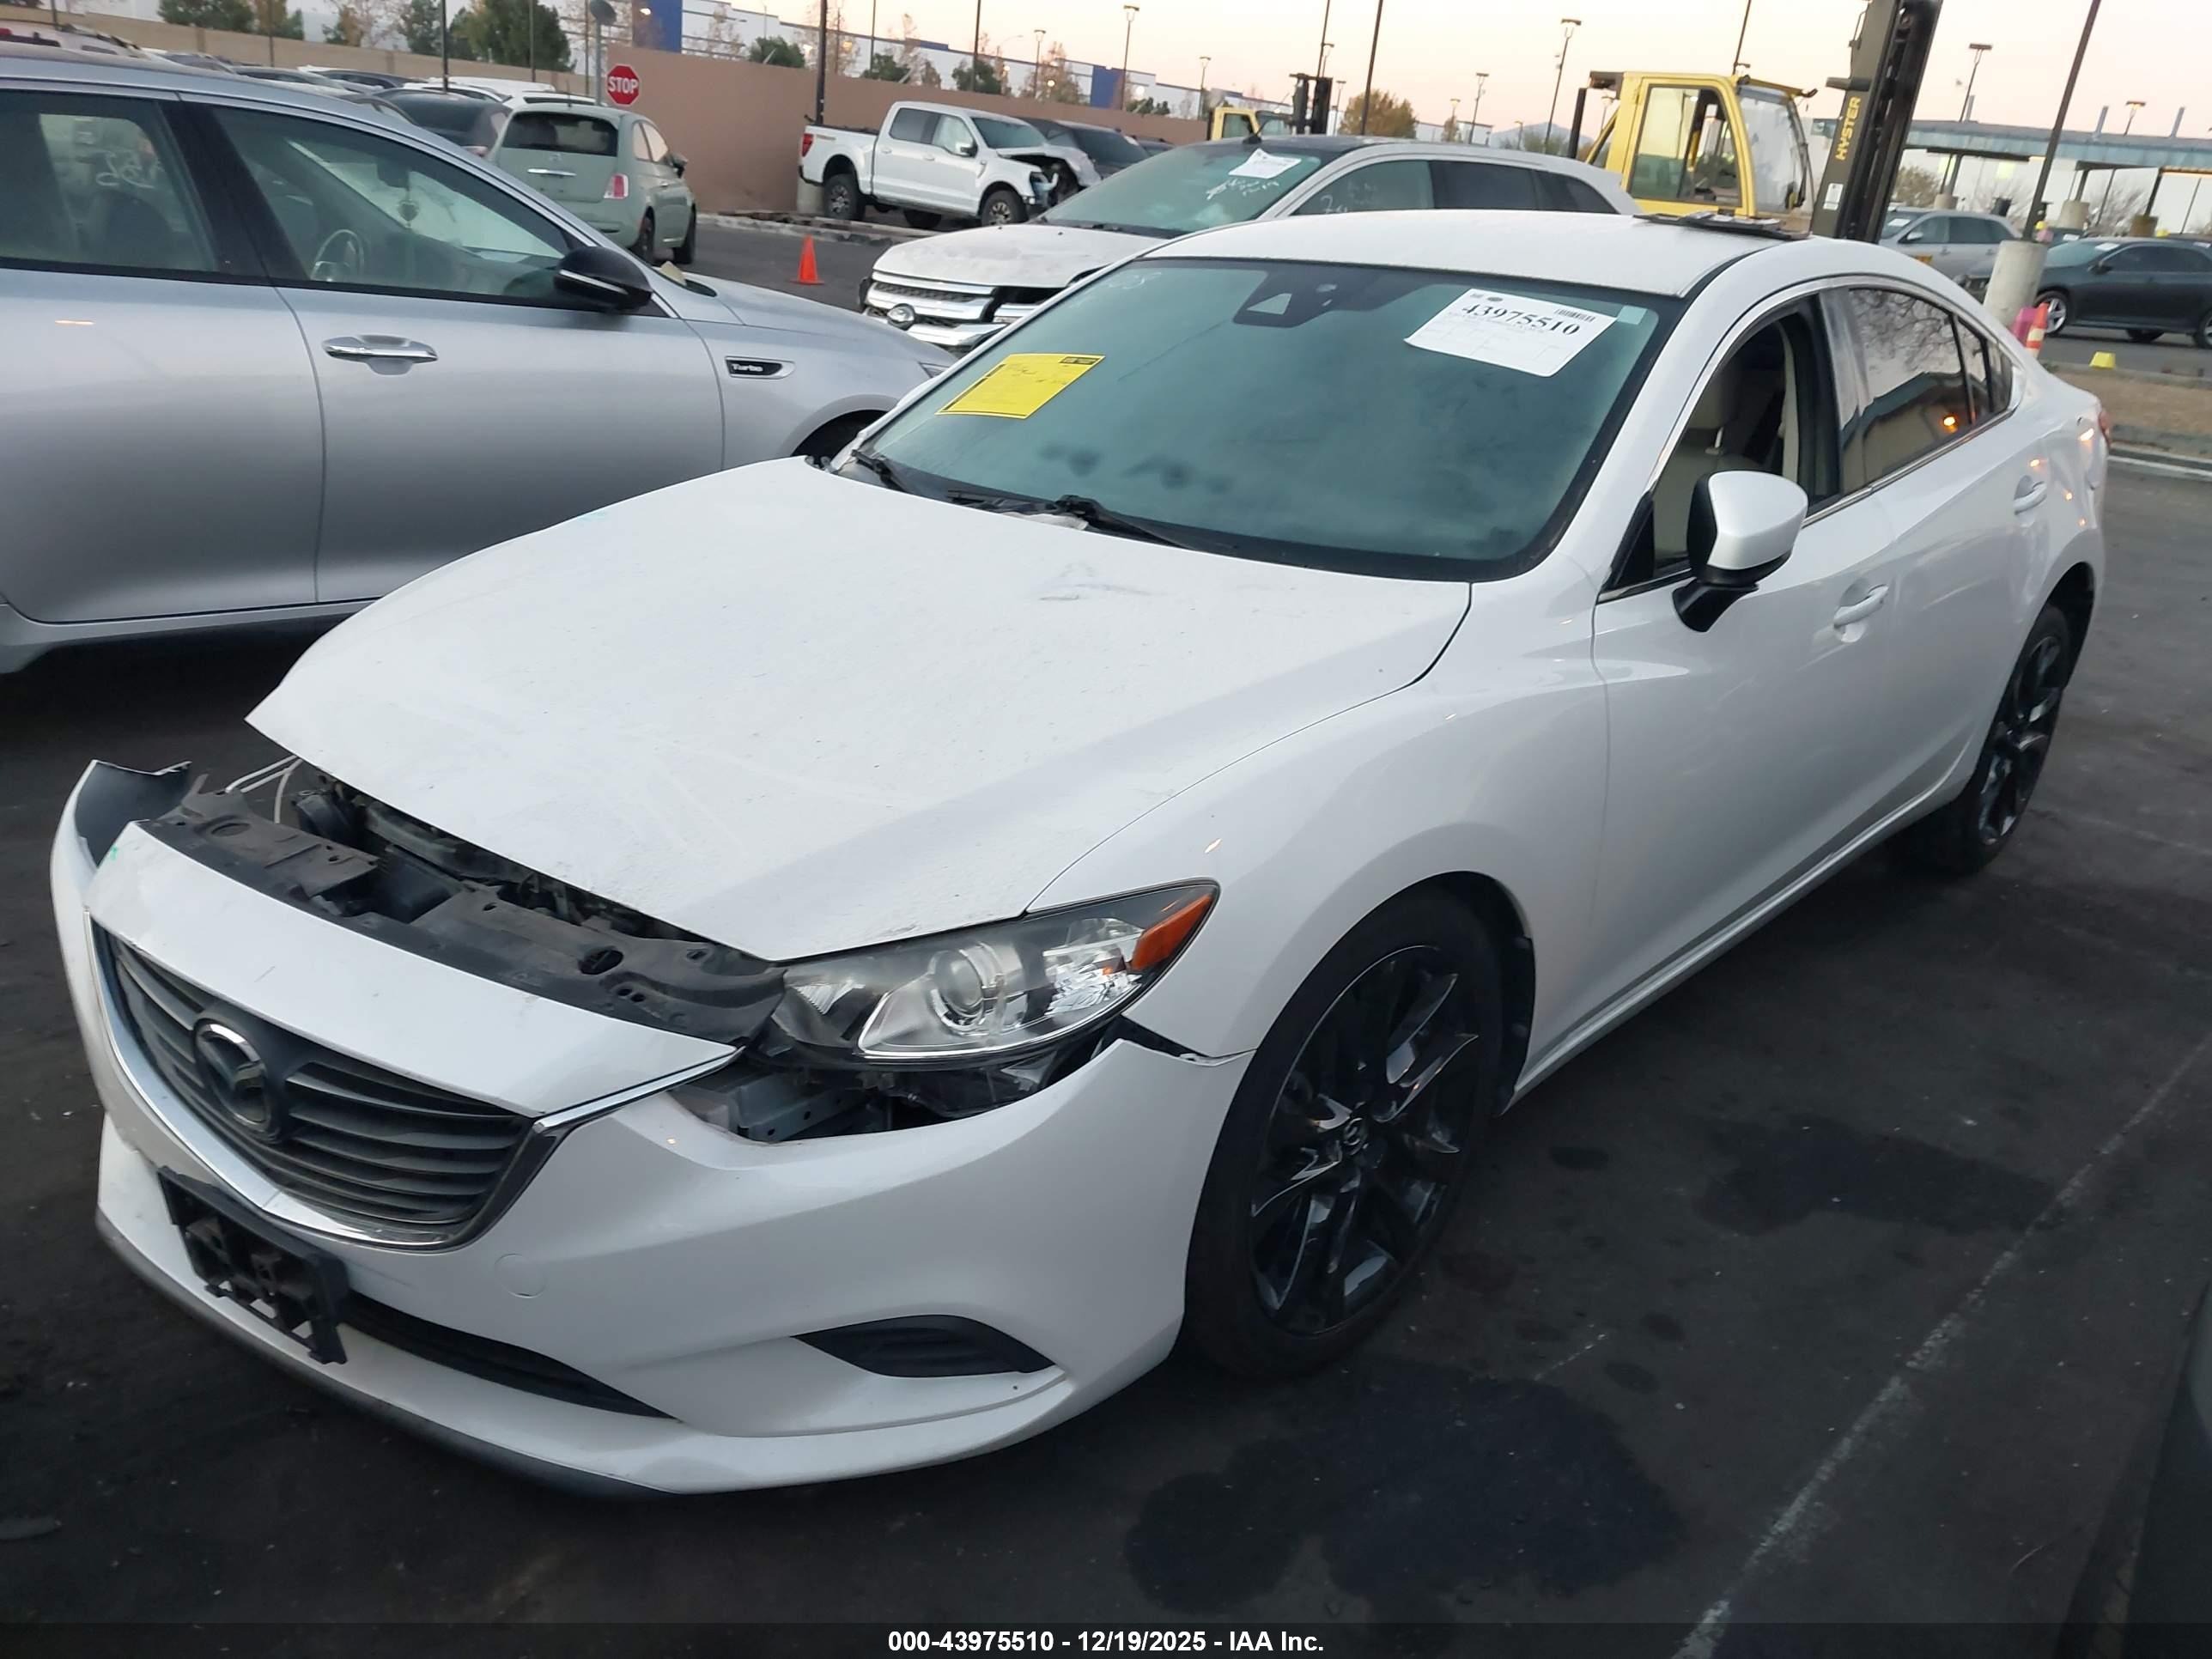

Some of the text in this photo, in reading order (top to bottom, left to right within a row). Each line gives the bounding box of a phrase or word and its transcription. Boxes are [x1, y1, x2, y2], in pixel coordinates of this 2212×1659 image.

[608, 76, 639, 94] STOP
[1835, 96, 1861, 161] HYSTER
[1462, 303, 1581, 336] 43975510
